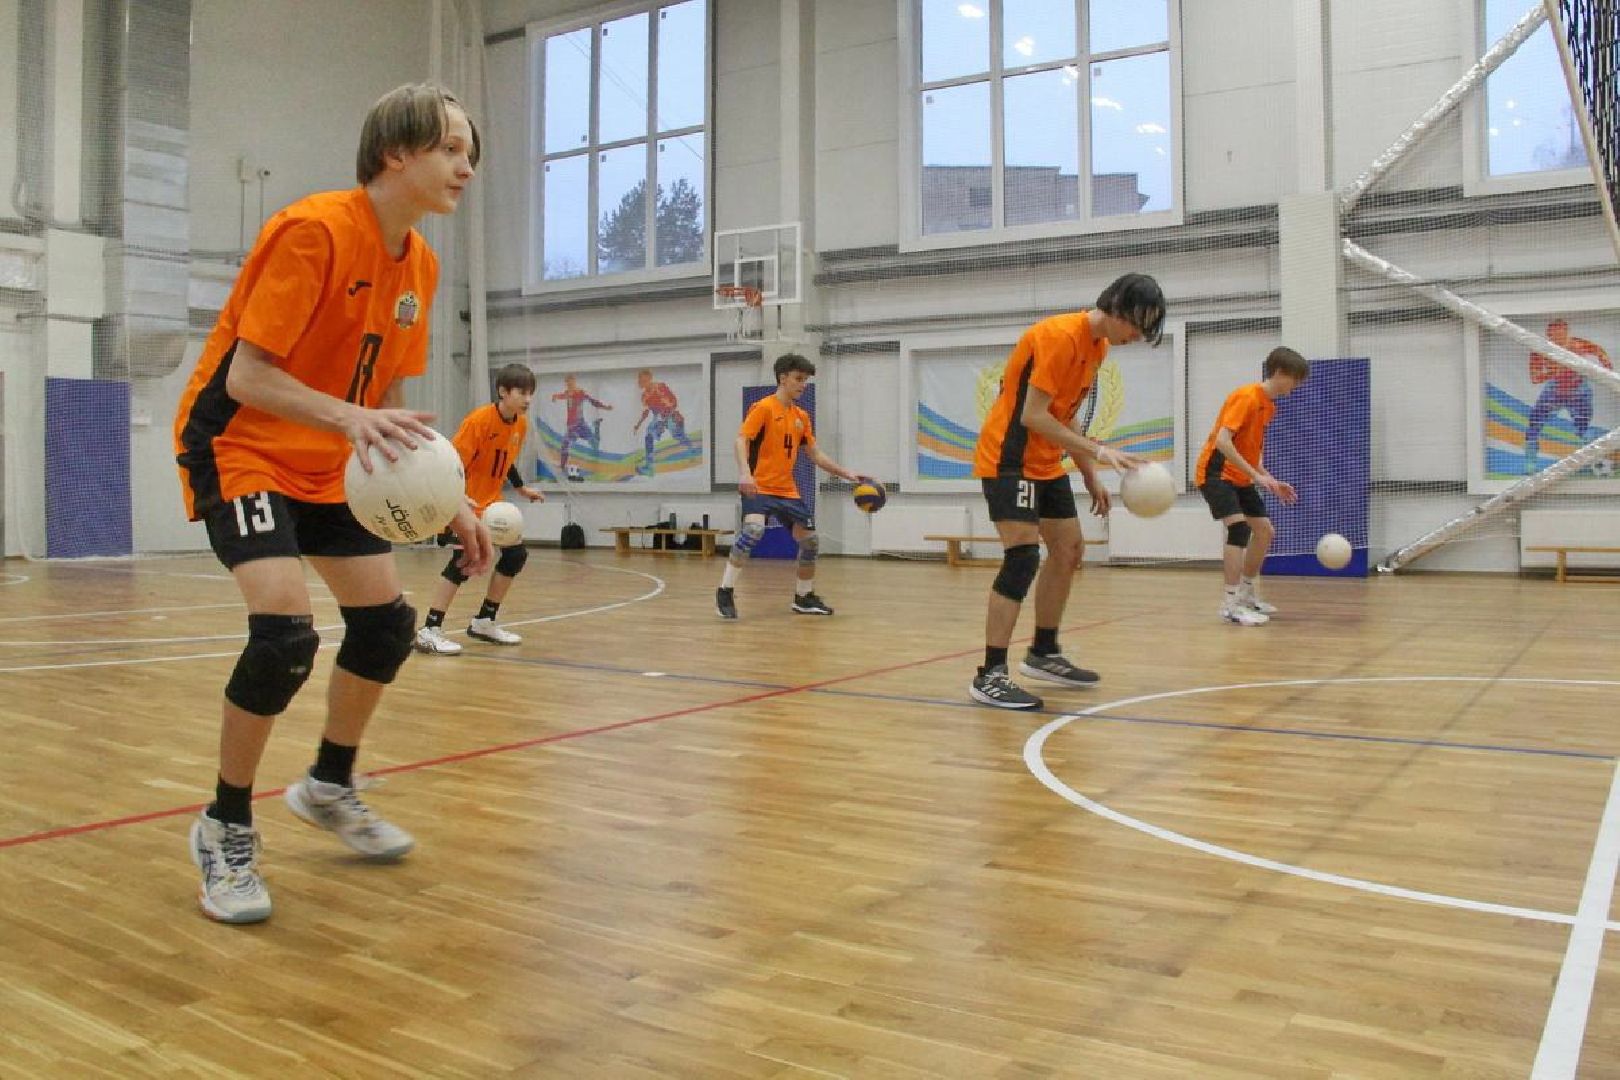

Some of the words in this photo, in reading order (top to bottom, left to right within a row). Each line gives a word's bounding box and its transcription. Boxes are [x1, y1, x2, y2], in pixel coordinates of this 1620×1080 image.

[784, 433, 793, 459] 4
[491, 449, 508, 477] 11
[1017, 480, 1035, 508] 21
[233, 491, 275, 537] 13
[386, 499, 418, 540] JÖGE
